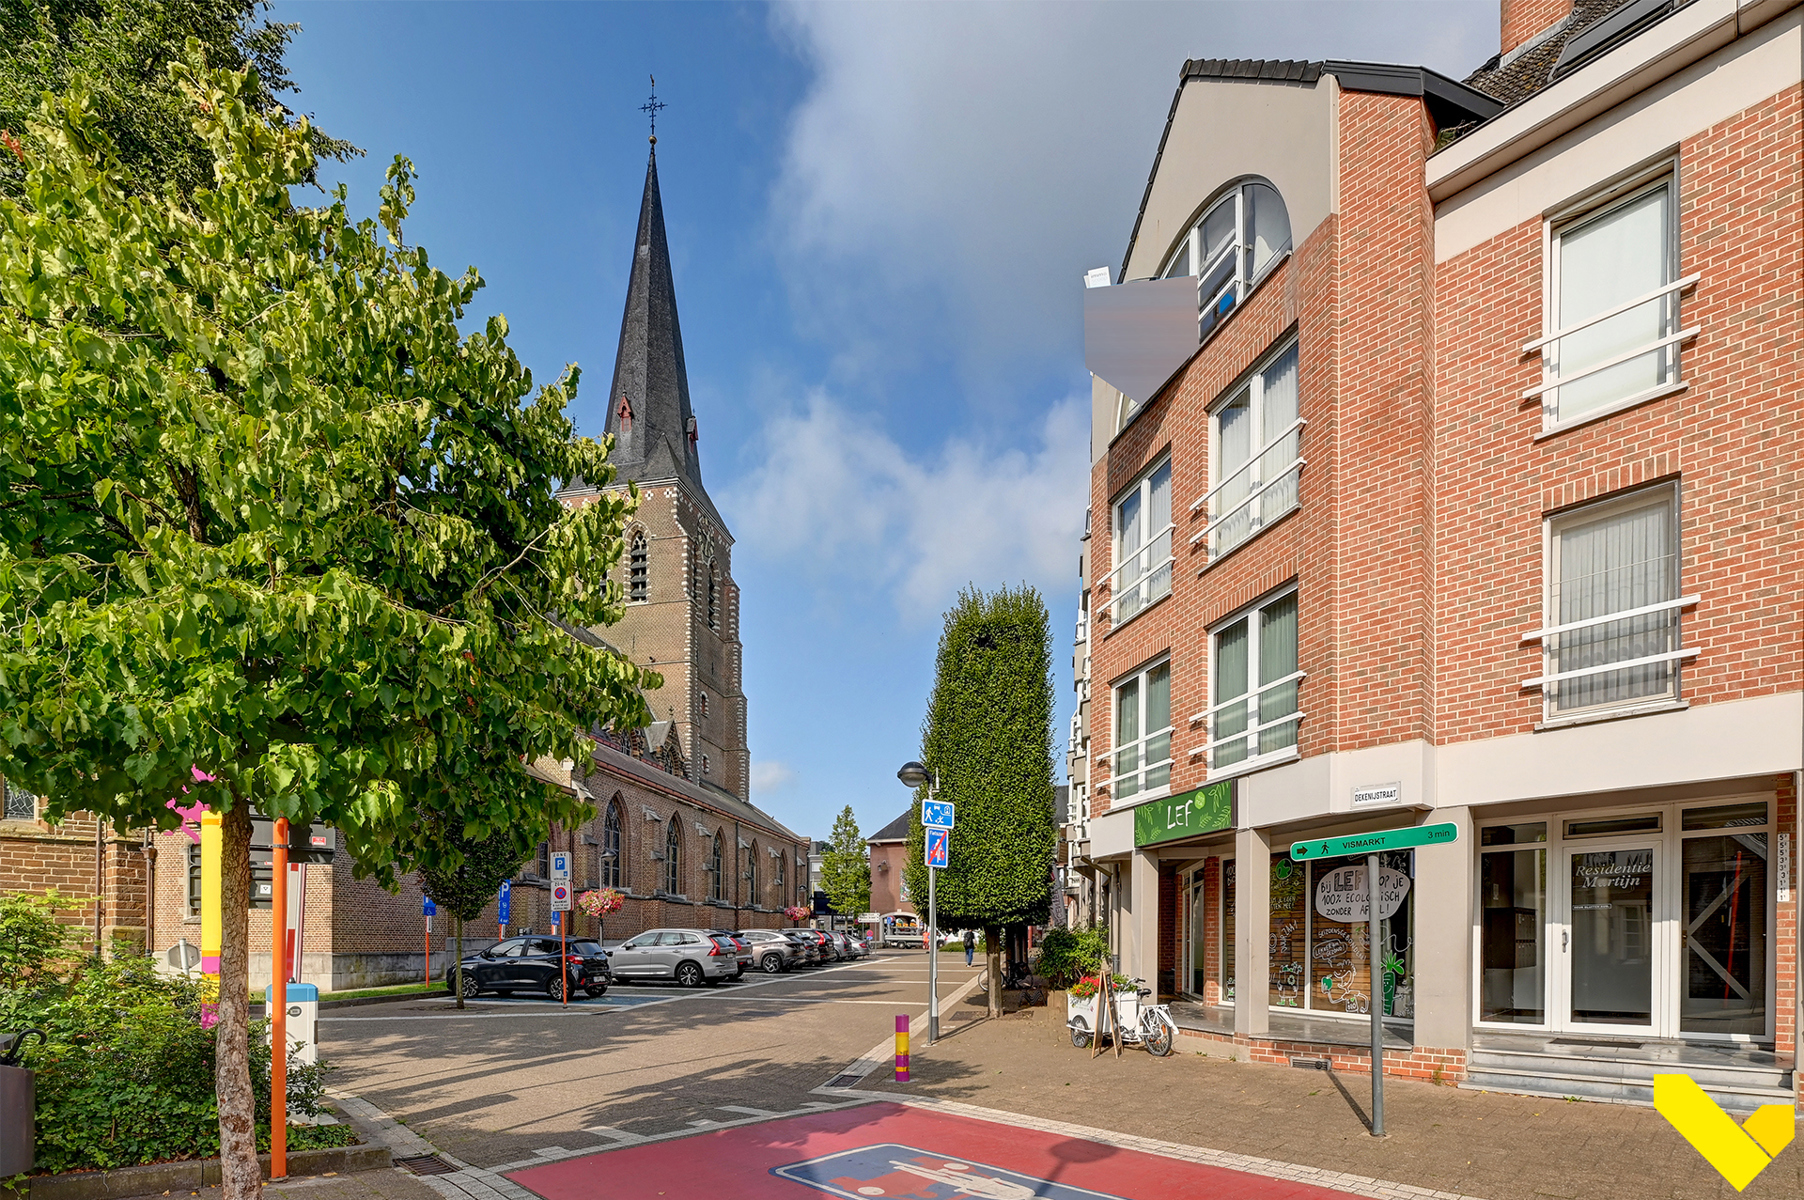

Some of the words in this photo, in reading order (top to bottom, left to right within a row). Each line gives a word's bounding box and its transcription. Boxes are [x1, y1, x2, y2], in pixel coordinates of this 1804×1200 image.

[1354, 789, 1397, 802] DEKENIJSTRAAT
[1167, 799, 1194, 830] LEF
[1342, 837, 1386, 849] VISMARKT
[1427, 831, 1434, 839] 3
[1434, 830, 1450, 838] min
[557, 860, 563, 868] P
[1575, 861, 1651, 877] Residentie
[1333, 869, 1364, 892] LEF
[1581, 874, 1640, 889] Martijn
[1321, 894, 1342, 906] 100%
[1326, 906, 1352, 916] ZONDER
[1359, 904, 1390, 916] AFL!
